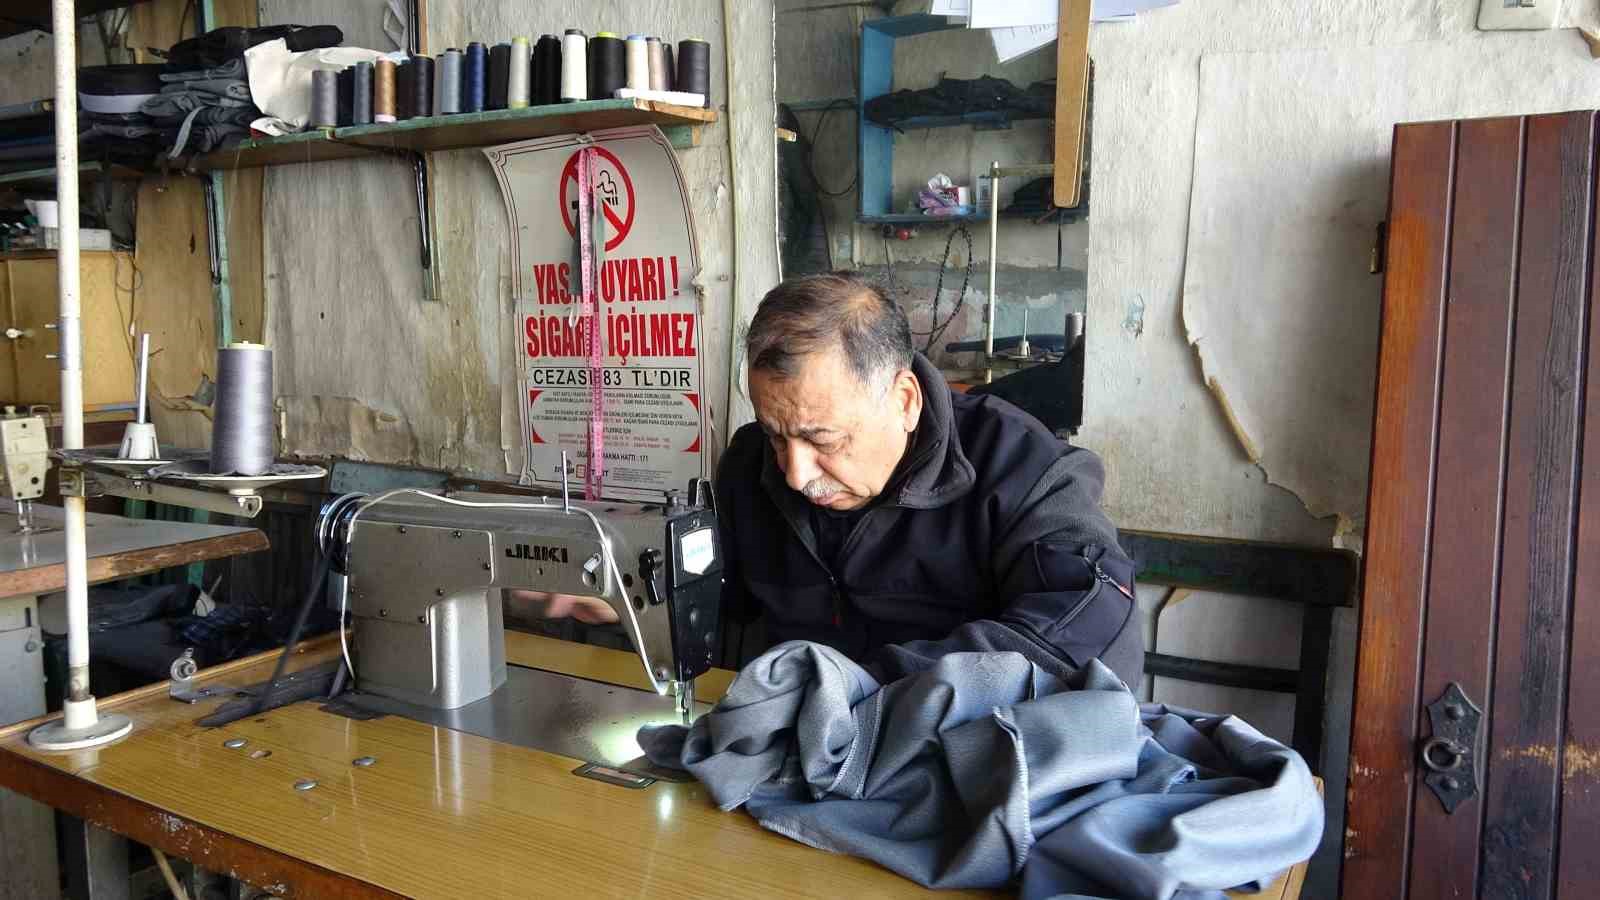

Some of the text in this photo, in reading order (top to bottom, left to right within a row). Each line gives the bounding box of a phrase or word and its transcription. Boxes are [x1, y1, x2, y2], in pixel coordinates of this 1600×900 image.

[533, 262, 594, 305] YAS
[601, 256, 666, 303] UYARI
[526, 306, 696, 366] SİGAR İÇİLMEZ
[603, 370, 622, 386] 83
[631, 370, 691, 387] TL'DIR
